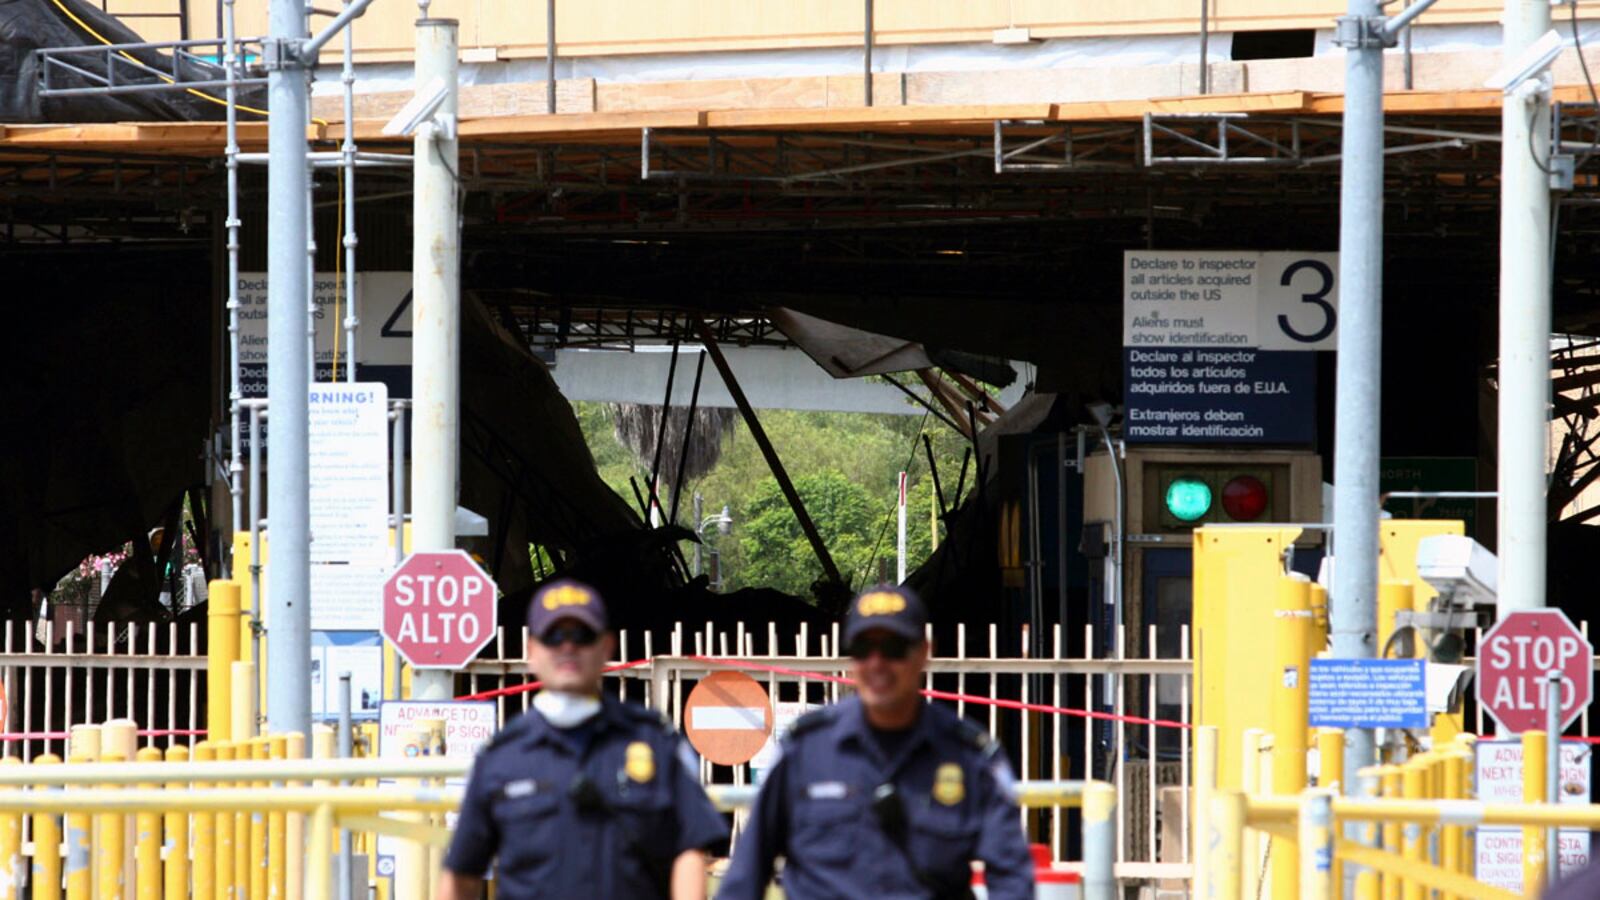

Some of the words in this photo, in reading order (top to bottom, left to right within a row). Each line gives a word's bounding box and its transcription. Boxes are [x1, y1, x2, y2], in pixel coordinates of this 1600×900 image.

[1130, 257, 1178, 269] Declare
[1182, 258, 1195, 269] to
[1199, 257, 1256, 272] inspector
[238, 280, 268, 290] Decla
[1130, 273, 1145, 285] all
[1149, 273, 1194, 285] articles
[1197, 273, 1251, 288] acquired
[1130, 289, 1177, 301] outside
[1180, 289, 1200, 301] the
[1203, 289, 1222, 301] US
[1277, 259, 1337, 343] 3
[1132, 316, 1170, 329] Aliens
[1173, 317, 1204, 329] must
[240, 335, 268, 346] Alien
[1132, 332, 1165, 344] show
[1169, 332, 1248, 344] identification
[1130, 350, 1178, 362] Declare
[1182, 350, 1194, 362] al
[1197, 350, 1256, 365] inspector
[239, 367, 268, 378] Decla
[1130, 366, 1167, 378] todos
[1170, 366, 1189, 378] los
[1192, 366, 1246, 378] artículos
[238, 381, 268, 393] todo
[1130, 382, 1195, 395] adquiridos
[1198, 382, 1231, 394] fuera
[1234, 382, 1250, 394] de
[1254, 382, 1290, 394] E.U.A.
[309, 391, 374, 404] RNING!
[1130, 409, 1201, 423] Extranjeros
[1203, 409, 1244, 421] deben
[1130, 425, 1178, 437] mostrar
[1182, 424, 1264, 437] identificación
[394, 574, 483, 607] STOP
[397, 612, 480, 644] ALTO
[1491, 635, 1579, 670] STOP
[1493, 676, 1576, 711] ALTO
[462, 708, 478, 721] TO
[459, 726, 490, 739] SIGN
[1482, 768, 1513, 780] NEXT
